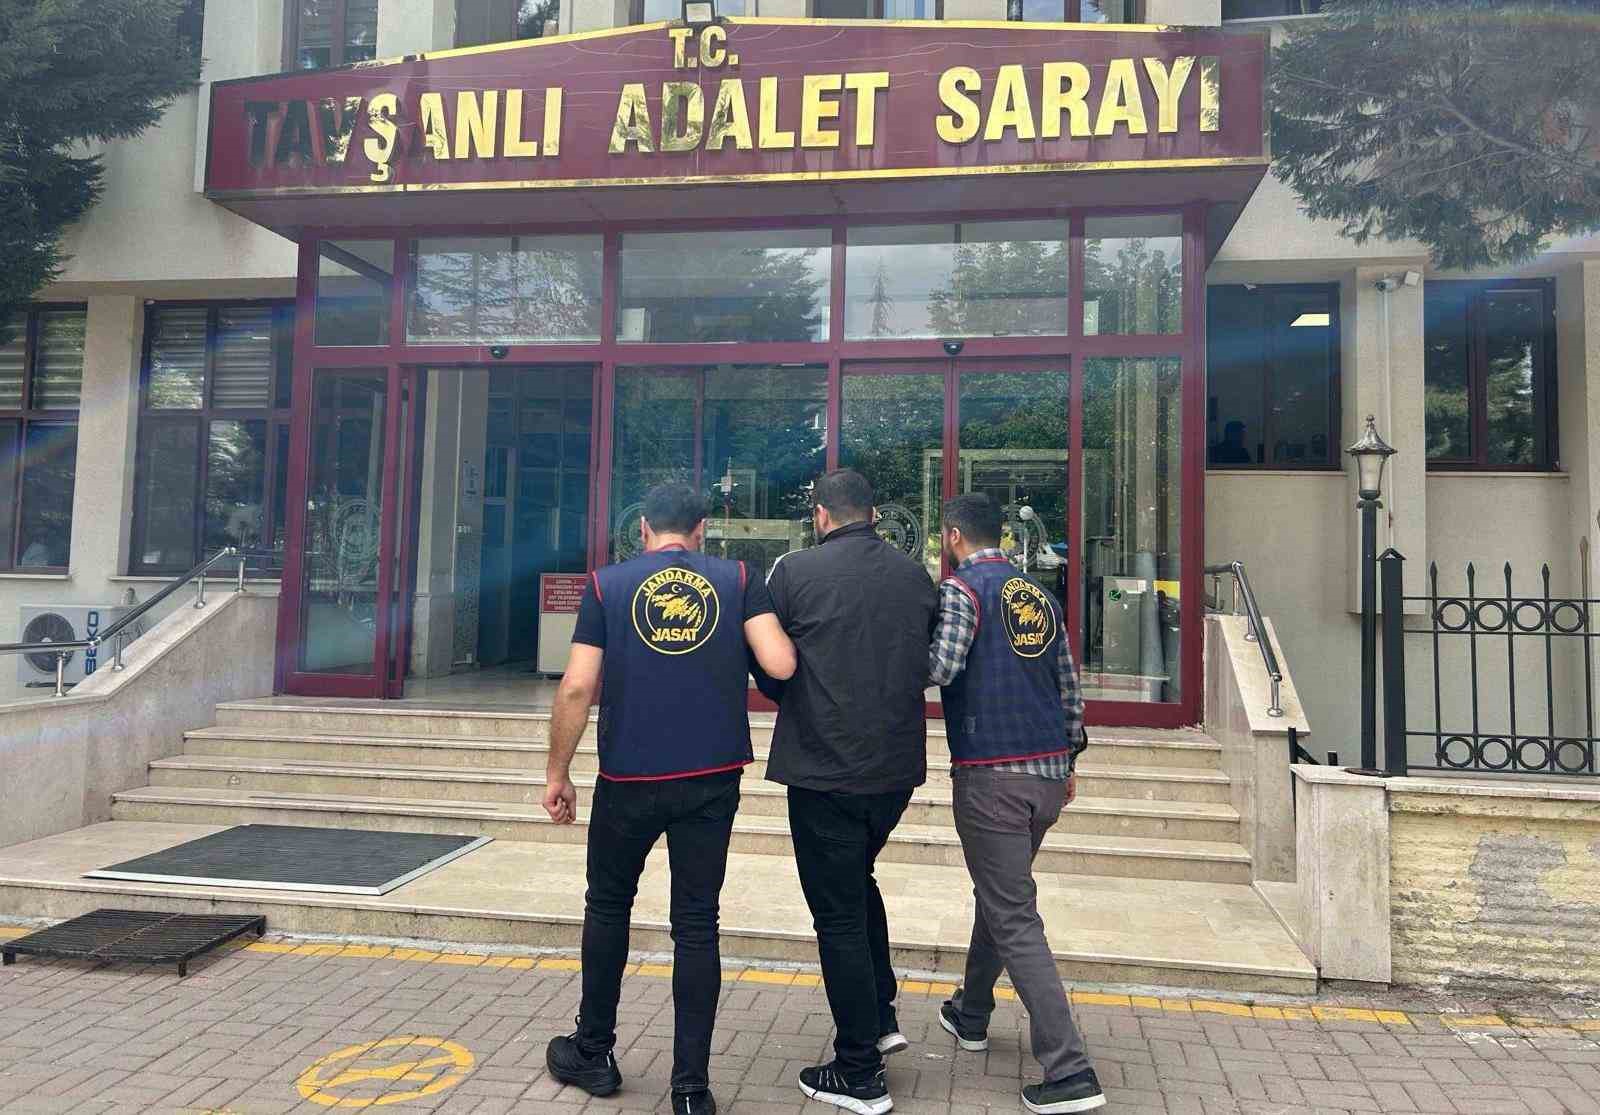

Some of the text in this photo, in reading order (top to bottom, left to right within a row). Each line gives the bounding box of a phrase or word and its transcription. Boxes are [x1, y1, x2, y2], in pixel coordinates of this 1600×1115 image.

[669, 26, 738, 69] T.C.
[243, 55, 1220, 182] TAVŞANLI ADALET SARAYI
[641, 571, 712, 598] JANDARMA
[651, 628, 698, 642] JASAT
[1013, 633, 1045, 646] JASAT
